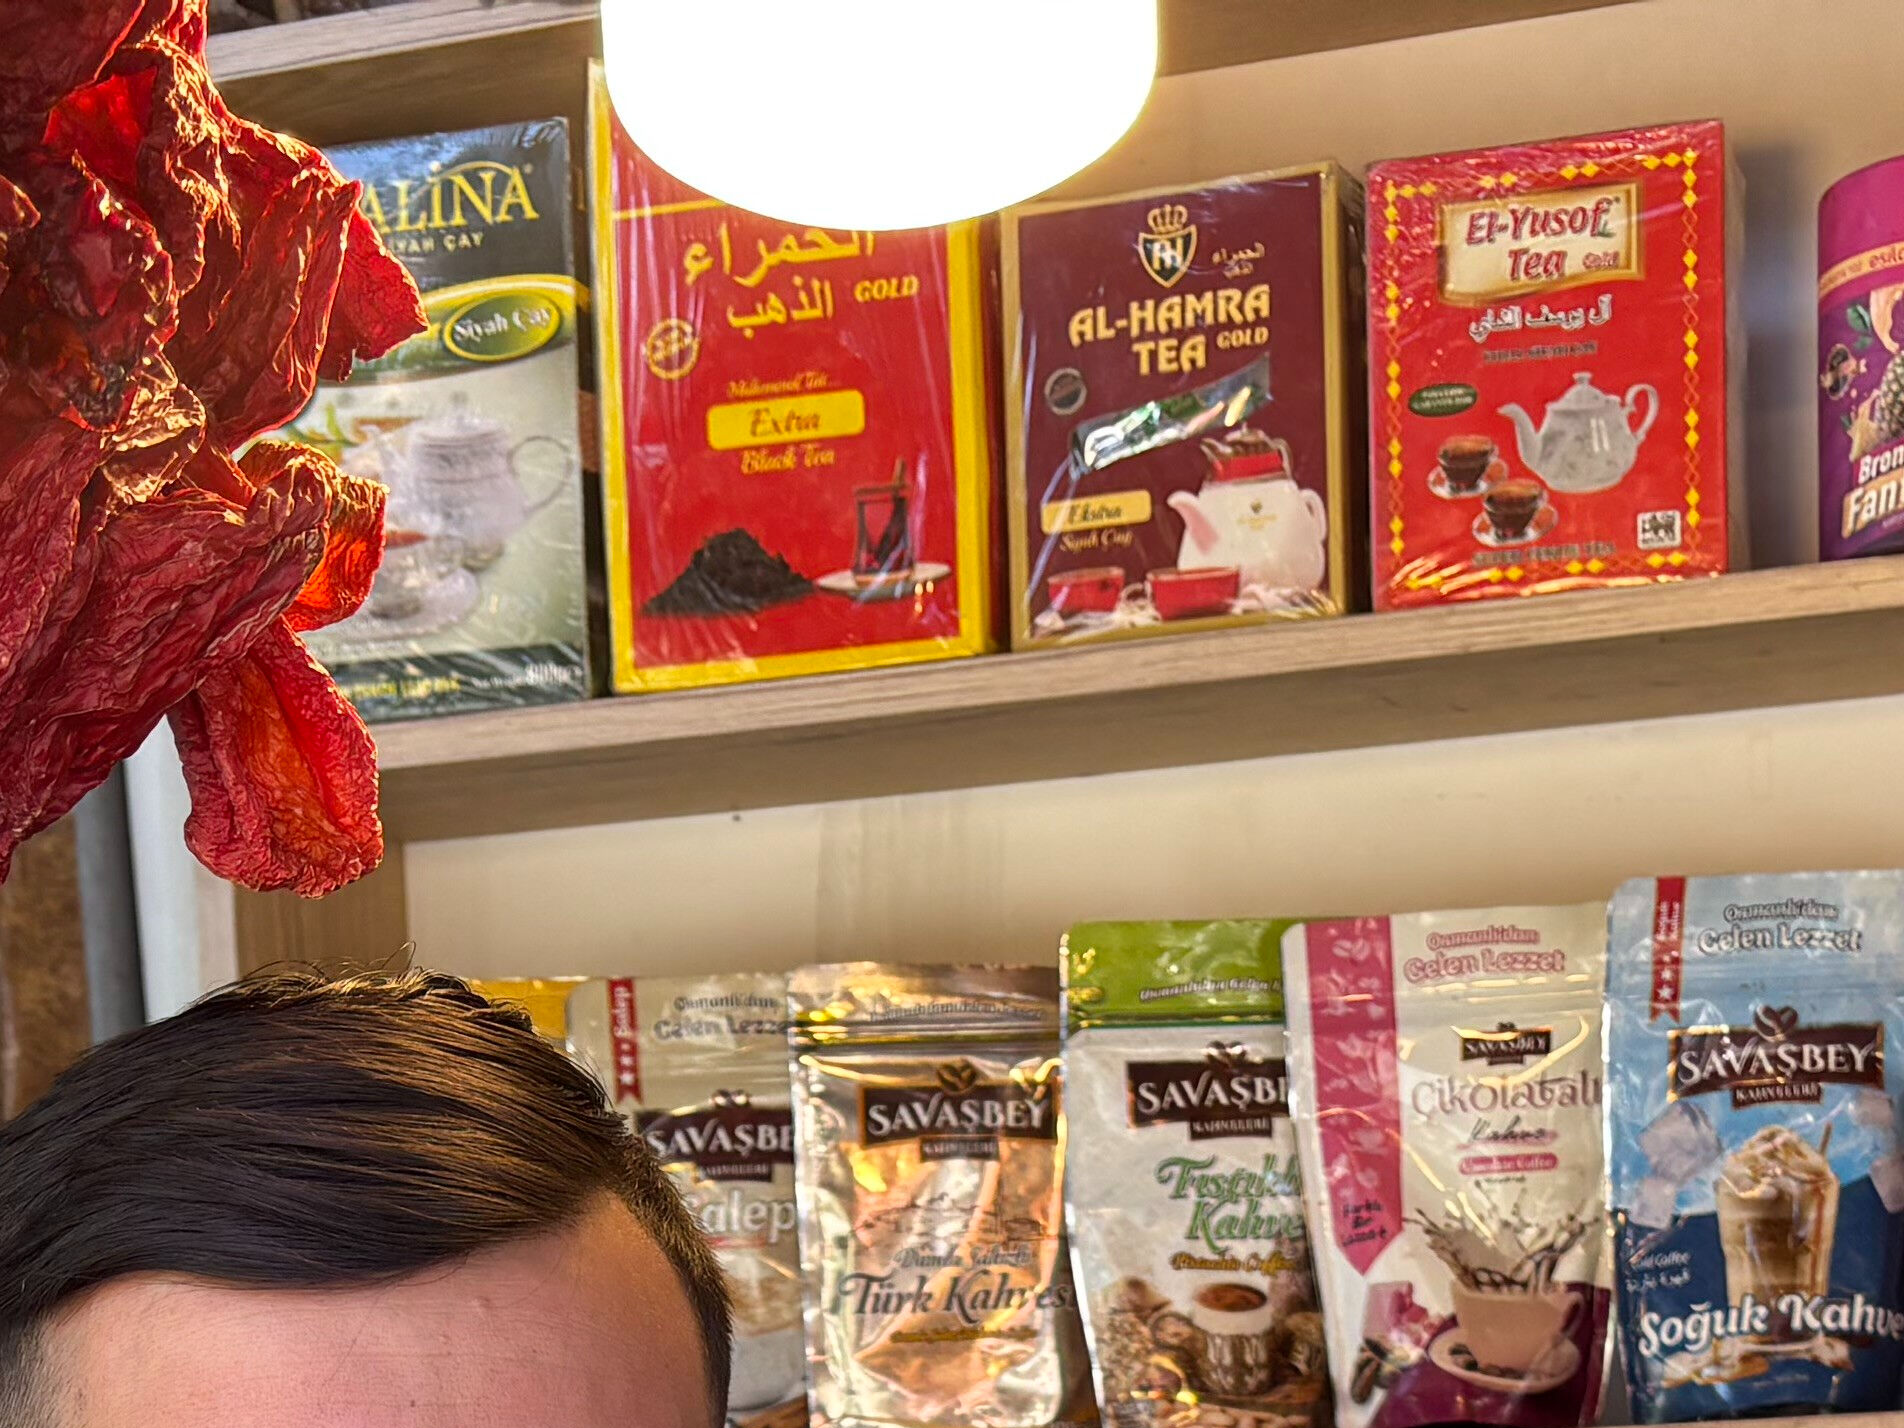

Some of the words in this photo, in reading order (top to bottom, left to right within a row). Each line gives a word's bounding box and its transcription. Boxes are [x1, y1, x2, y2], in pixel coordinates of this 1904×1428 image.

[1509, 248, 1569, 281] Tea
[853, 275, 919, 303] GOLD
[1068, 283, 1271, 348] AL-HAMRA
[1132, 334, 1208, 376] TEA
[1216, 326, 1270, 350] GOLD
[750, 407, 822, 439] Extra
[1698, 923, 1774, 955] Gelen
[1777, 920, 1864, 952] Lezzet
[1403, 954, 1480, 985] Gelen
[1677, 1034, 1877, 1087] SAVAŞBEY
[867, 1093, 1048, 1137] SAVAŞBEY
[701, 1189, 794, 1242] alep
[839, 1271, 934, 1315] Türk
[1638, 1293, 1771, 1358] Soğuk
